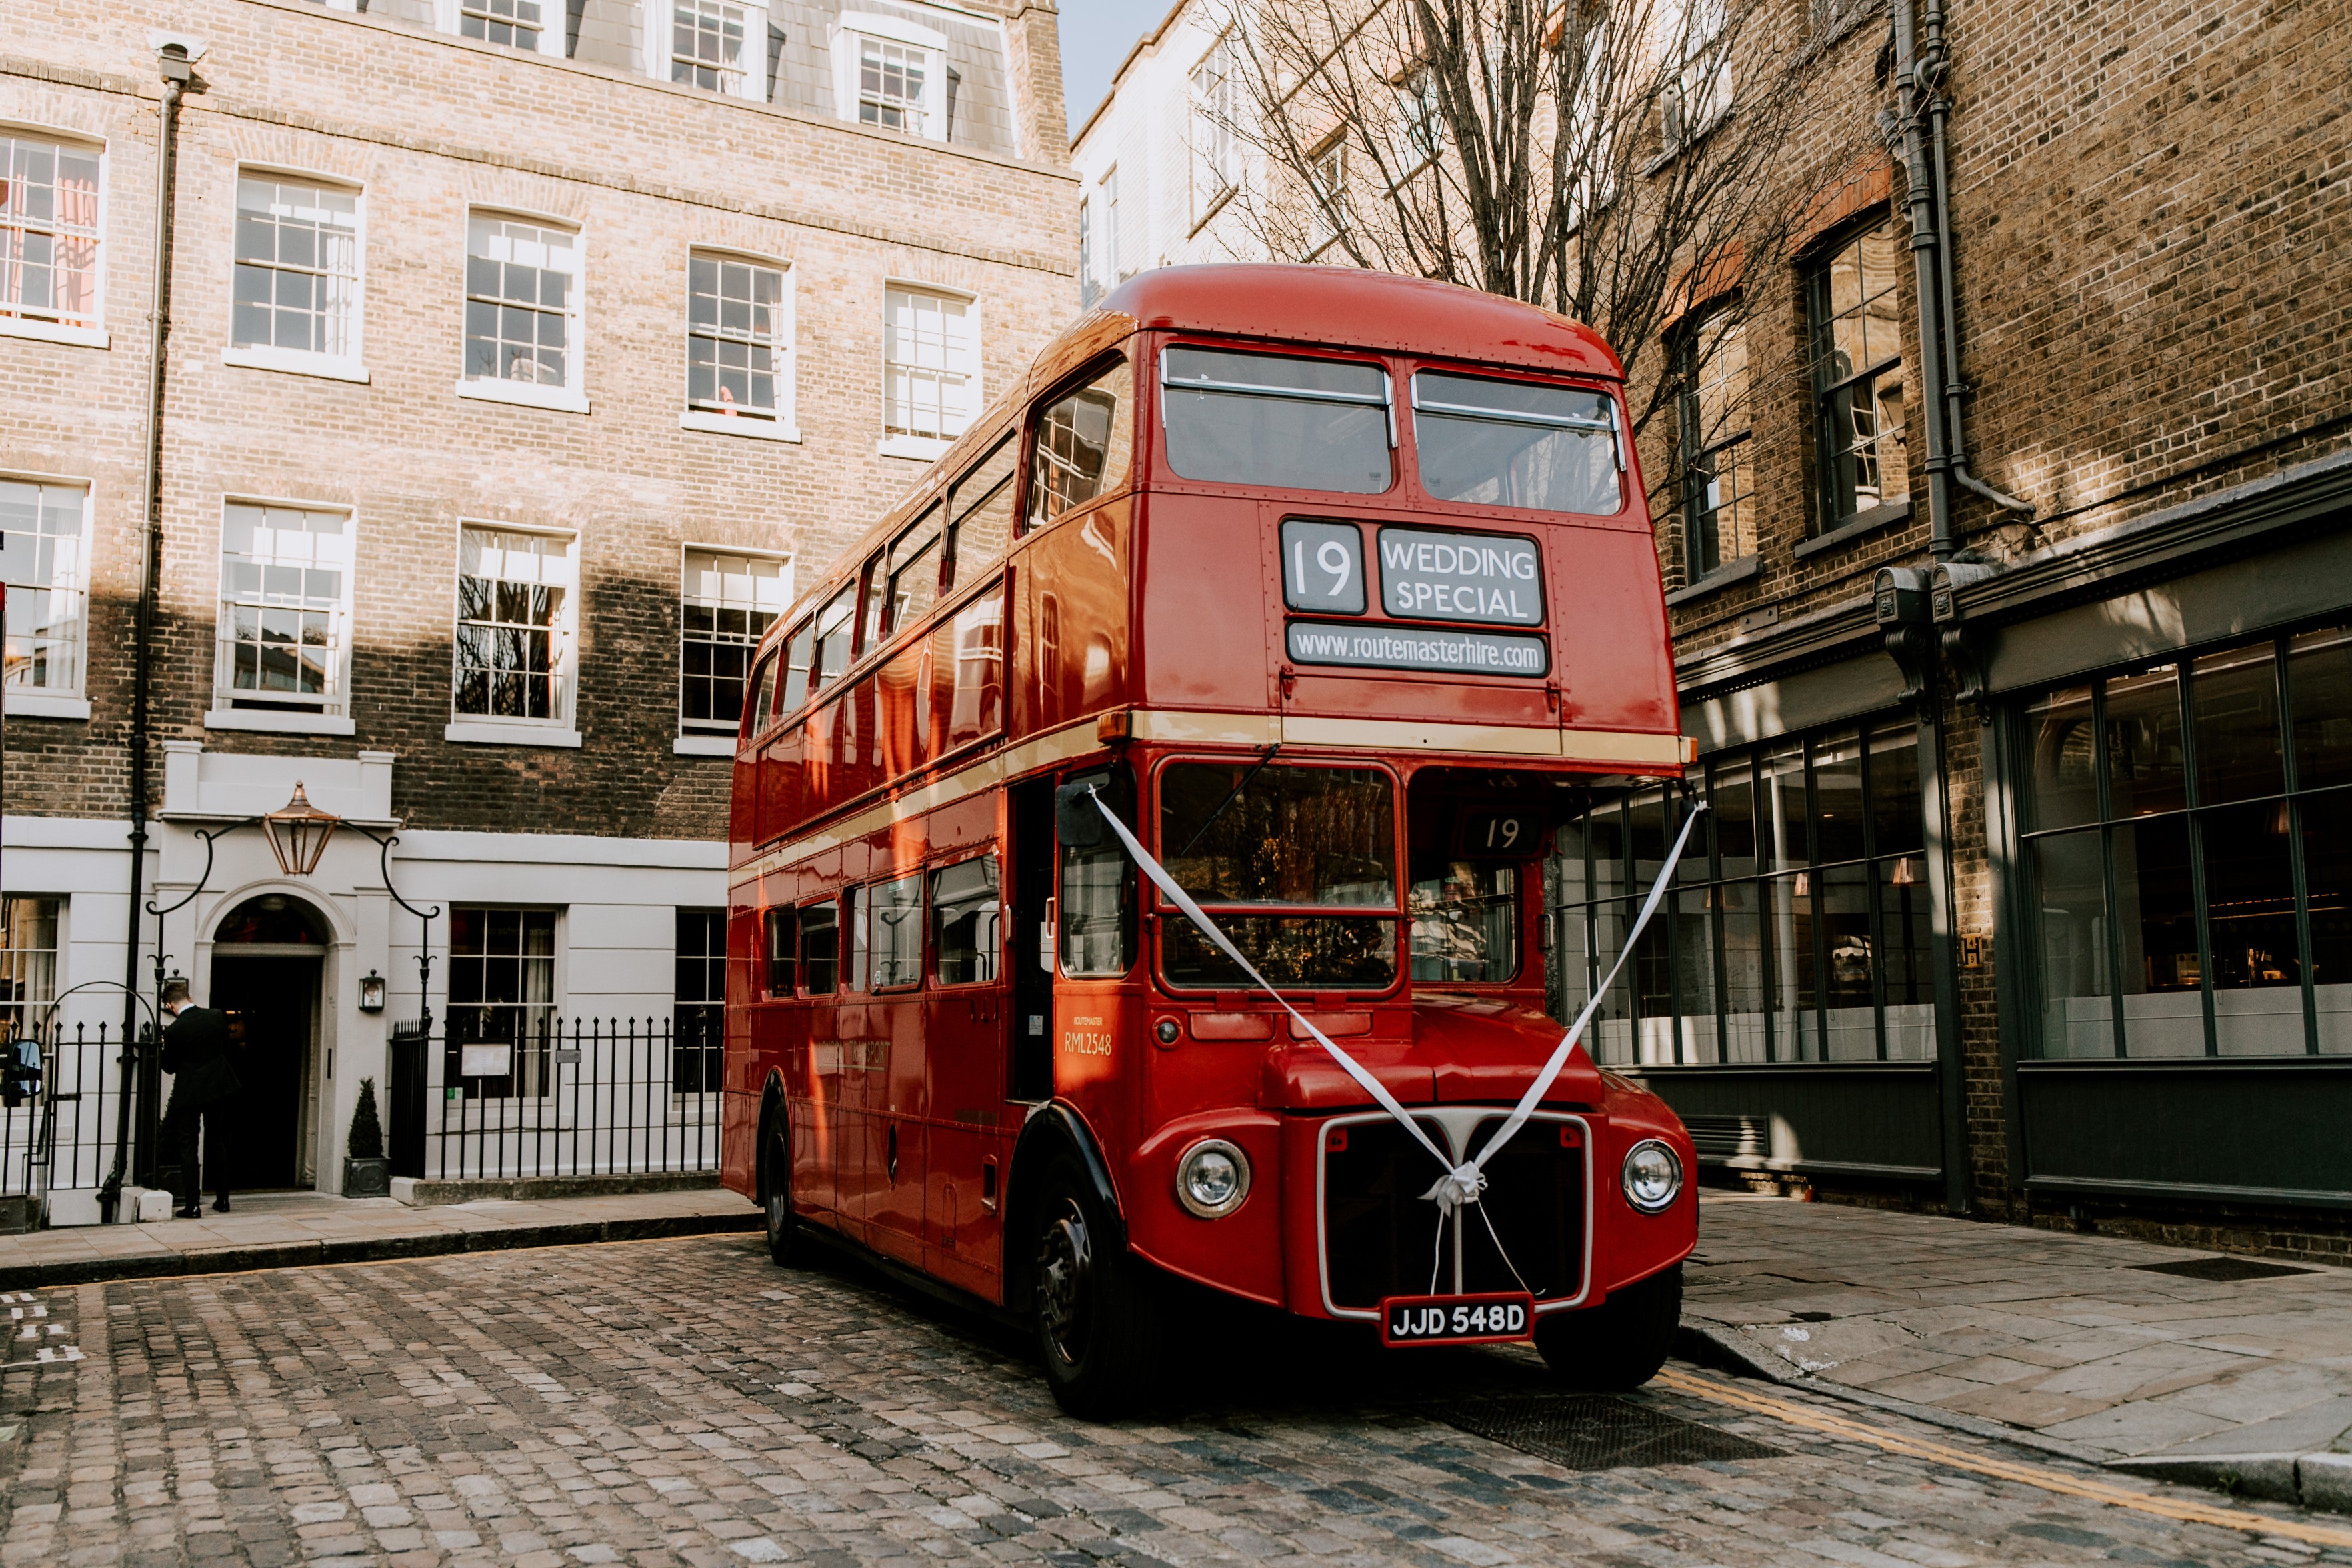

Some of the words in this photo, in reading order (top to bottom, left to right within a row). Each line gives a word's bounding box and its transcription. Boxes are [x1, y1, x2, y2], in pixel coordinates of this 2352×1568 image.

[1294, 539, 1351, 596] 19
[1381, 539, 1535, 580] WEDDING
[1396, 581, 1529, 619] SPECIAL
[1296, 633, 1539, 668] www.routemasterhire.com
[1487, 819, 1519, 848] 19
[1969, 939, 1973, 947] 4
[1970, 955, 1975, 963] 9
[1073, 1016, 1103, 1026] ROUTEMASTER
[1065, 1031, 1111, 1056] RML2548
[1392, 1308, 1445, 1336] JJD
[1451, 1305, 1525, 1333] 548D
